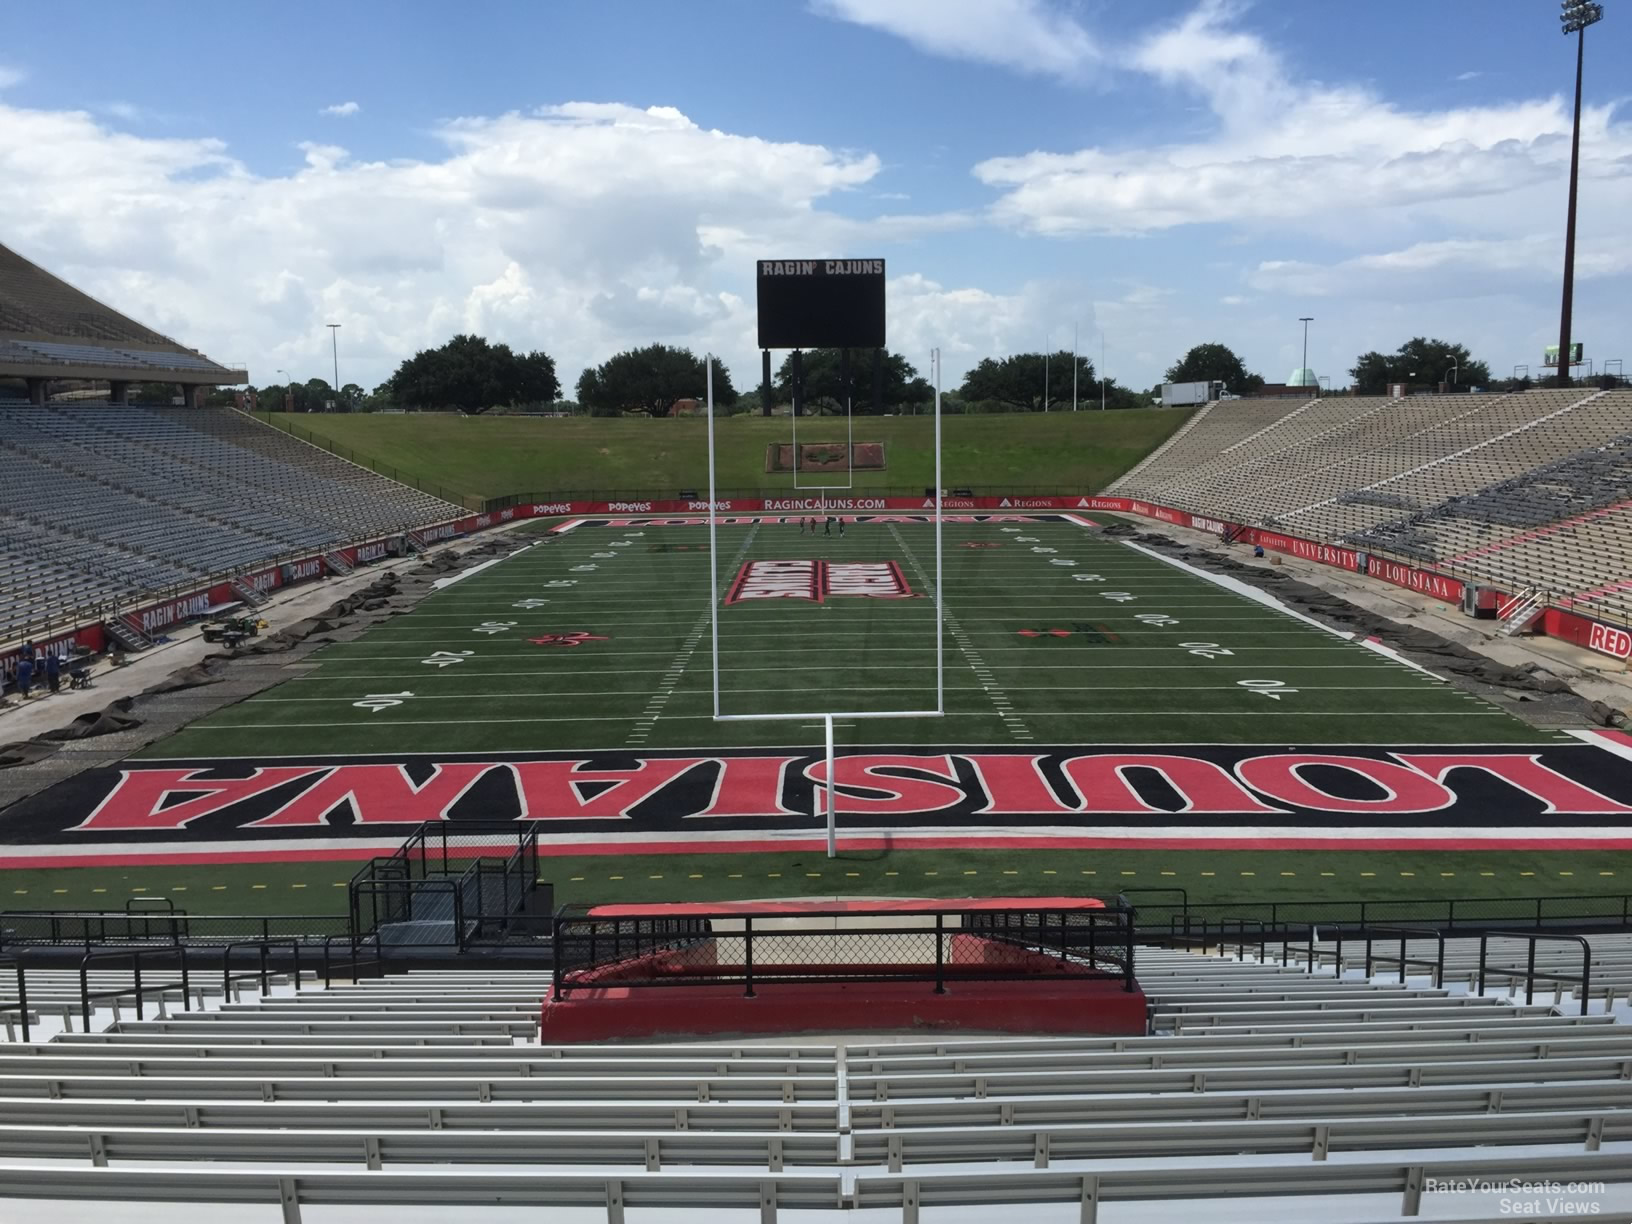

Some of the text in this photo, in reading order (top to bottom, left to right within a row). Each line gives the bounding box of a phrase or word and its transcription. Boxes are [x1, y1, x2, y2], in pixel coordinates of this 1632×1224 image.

[825, 260, 883, 274] CAJUNS
[764, 499, 885, 510] RAGINCAJUNS.COM
[292, 559, 321, 580] CAJUNS
[1292, 541, 1448, 597] UNIVERSITY OF LOUISIANA
[142, 593, 210, 632] RAGIN CAJUNS
[1178, 642, 1235, 656] 20
[1589, 622, 1632, 659] RED
[421, 650, 475, 665] 20
[1236, 679, 1299, 696] 10
[352, 691, 415, 709] 10
